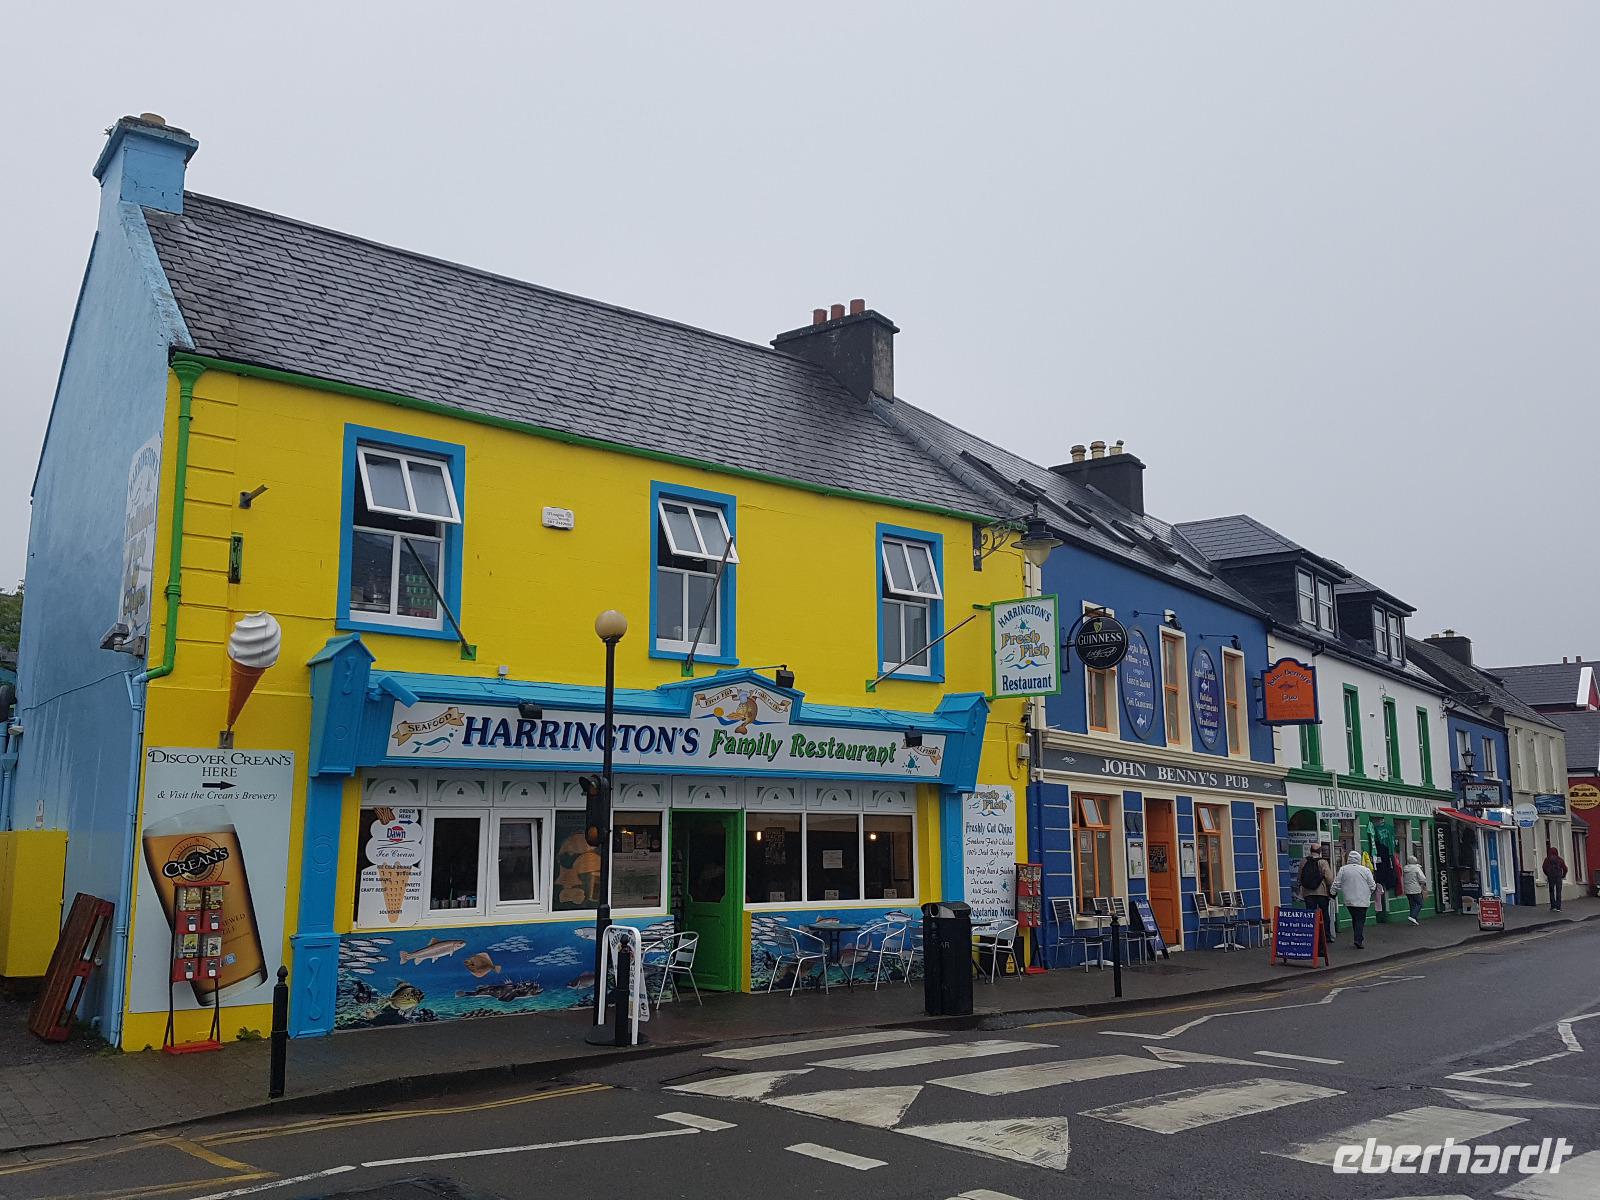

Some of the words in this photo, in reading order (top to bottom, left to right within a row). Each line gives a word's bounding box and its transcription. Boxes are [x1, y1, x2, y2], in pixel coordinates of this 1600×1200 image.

[998, 604, 1052, 628] HARRINGTON'S
[1001, 630, 1040, 650] Fresh
[1078, 633, 1122, 646] GUINNESS
[1020, 643, 1050, 661] Fish
[1002, 674, 1052, 691] Restaurant
[408, 713, 452, 732] SEAFOOD
[462, 716, 701, 756] HARRINGTON'S
[708, 728, 783, 762] Family
[789, 733, 897, 766] Restaurant
[148, 750, 226, 765] DISCOVER
[231, 752, 291, 766] CREAN'S
[202, 767, 238, 777] HERE
[1102, 759, 1147, 777] JOHN
[1157, 767, 1218, 786] BENNY'S
[1225, 774, 1250, 789] PUB
[157, 790, 165, 799] &
[168, 790, 188, 799] Visit
[190, 790, 204, 799] the
[207, 791, 240, 800] Crean's
[242, 791, 278, 801] Brewery
[1318, 788, 1335, 806] THE
[1338, 790, 1366, 809] DINGLE
[1370, 793, 1403, 813] WOOLLEN
[1405, 797, 1433, 815] COMPANY
[966, 822, 985, 835] Freshly
[987, 823, 996, 832] Cut
[998, 823, 1012, 834] Chips
[164, 848, 229, 876] CREAN'S
